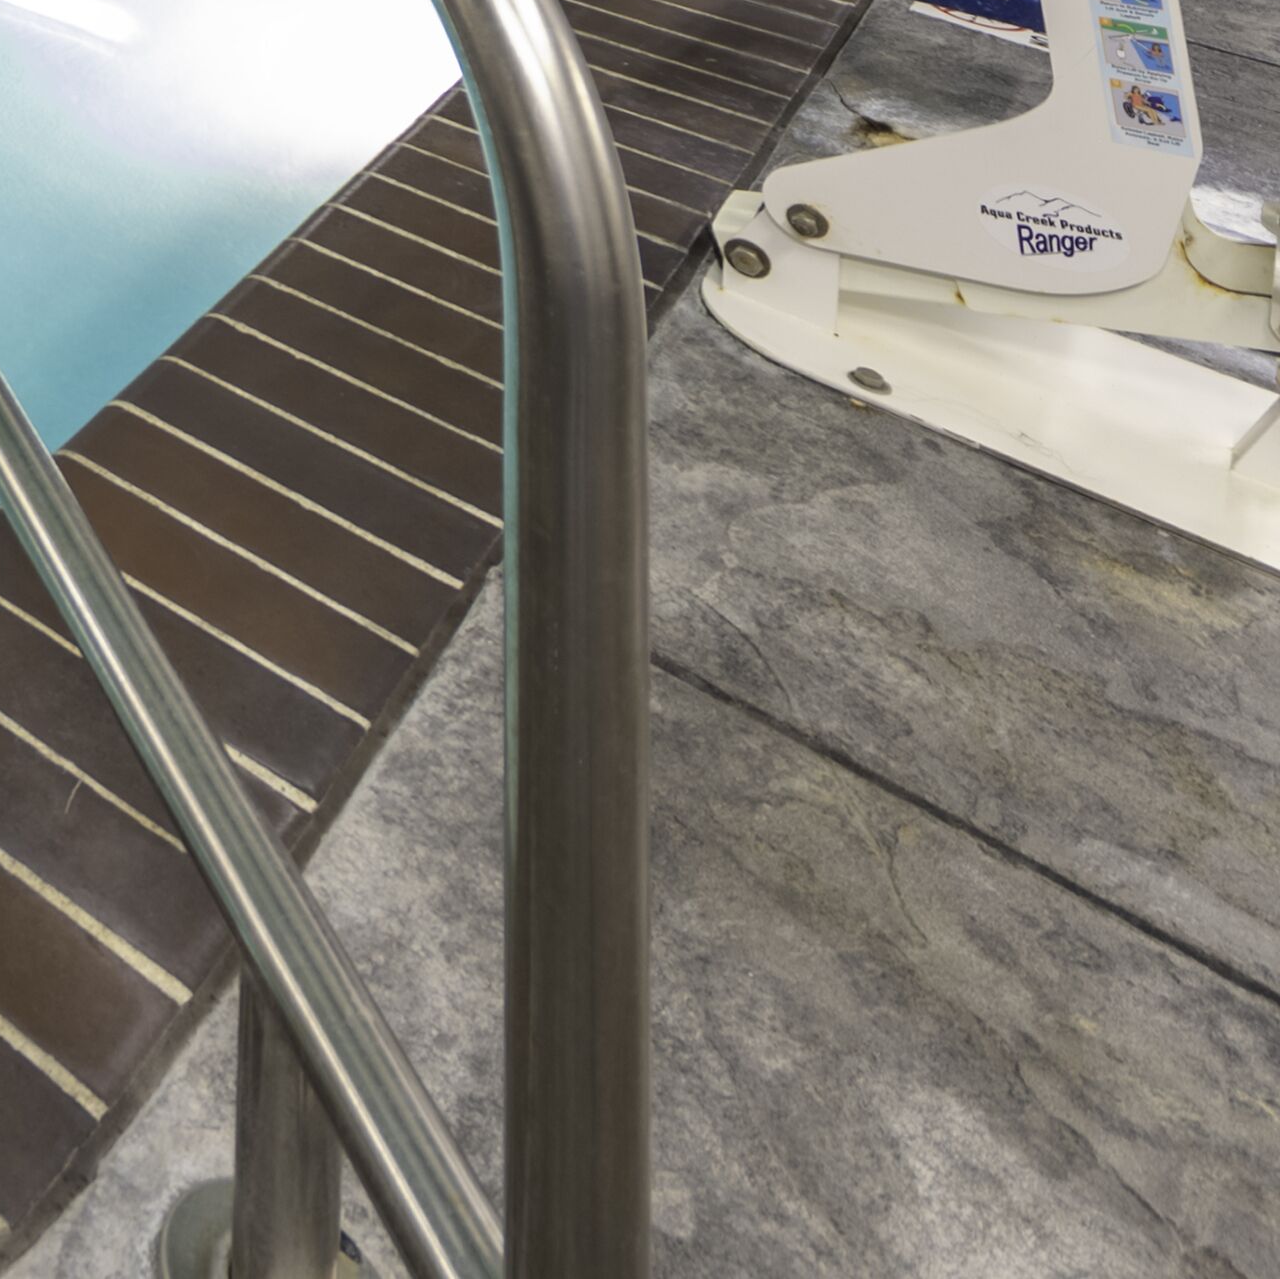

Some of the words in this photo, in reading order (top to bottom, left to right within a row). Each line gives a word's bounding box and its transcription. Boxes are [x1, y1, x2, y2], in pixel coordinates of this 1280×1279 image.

[980, 204, 1012, 220] Aqua
[1016, 211, 1056, 228] Creek
[1059, 219, 1123, 240] Products
[1017, 224, 1098, 258] Ranger
